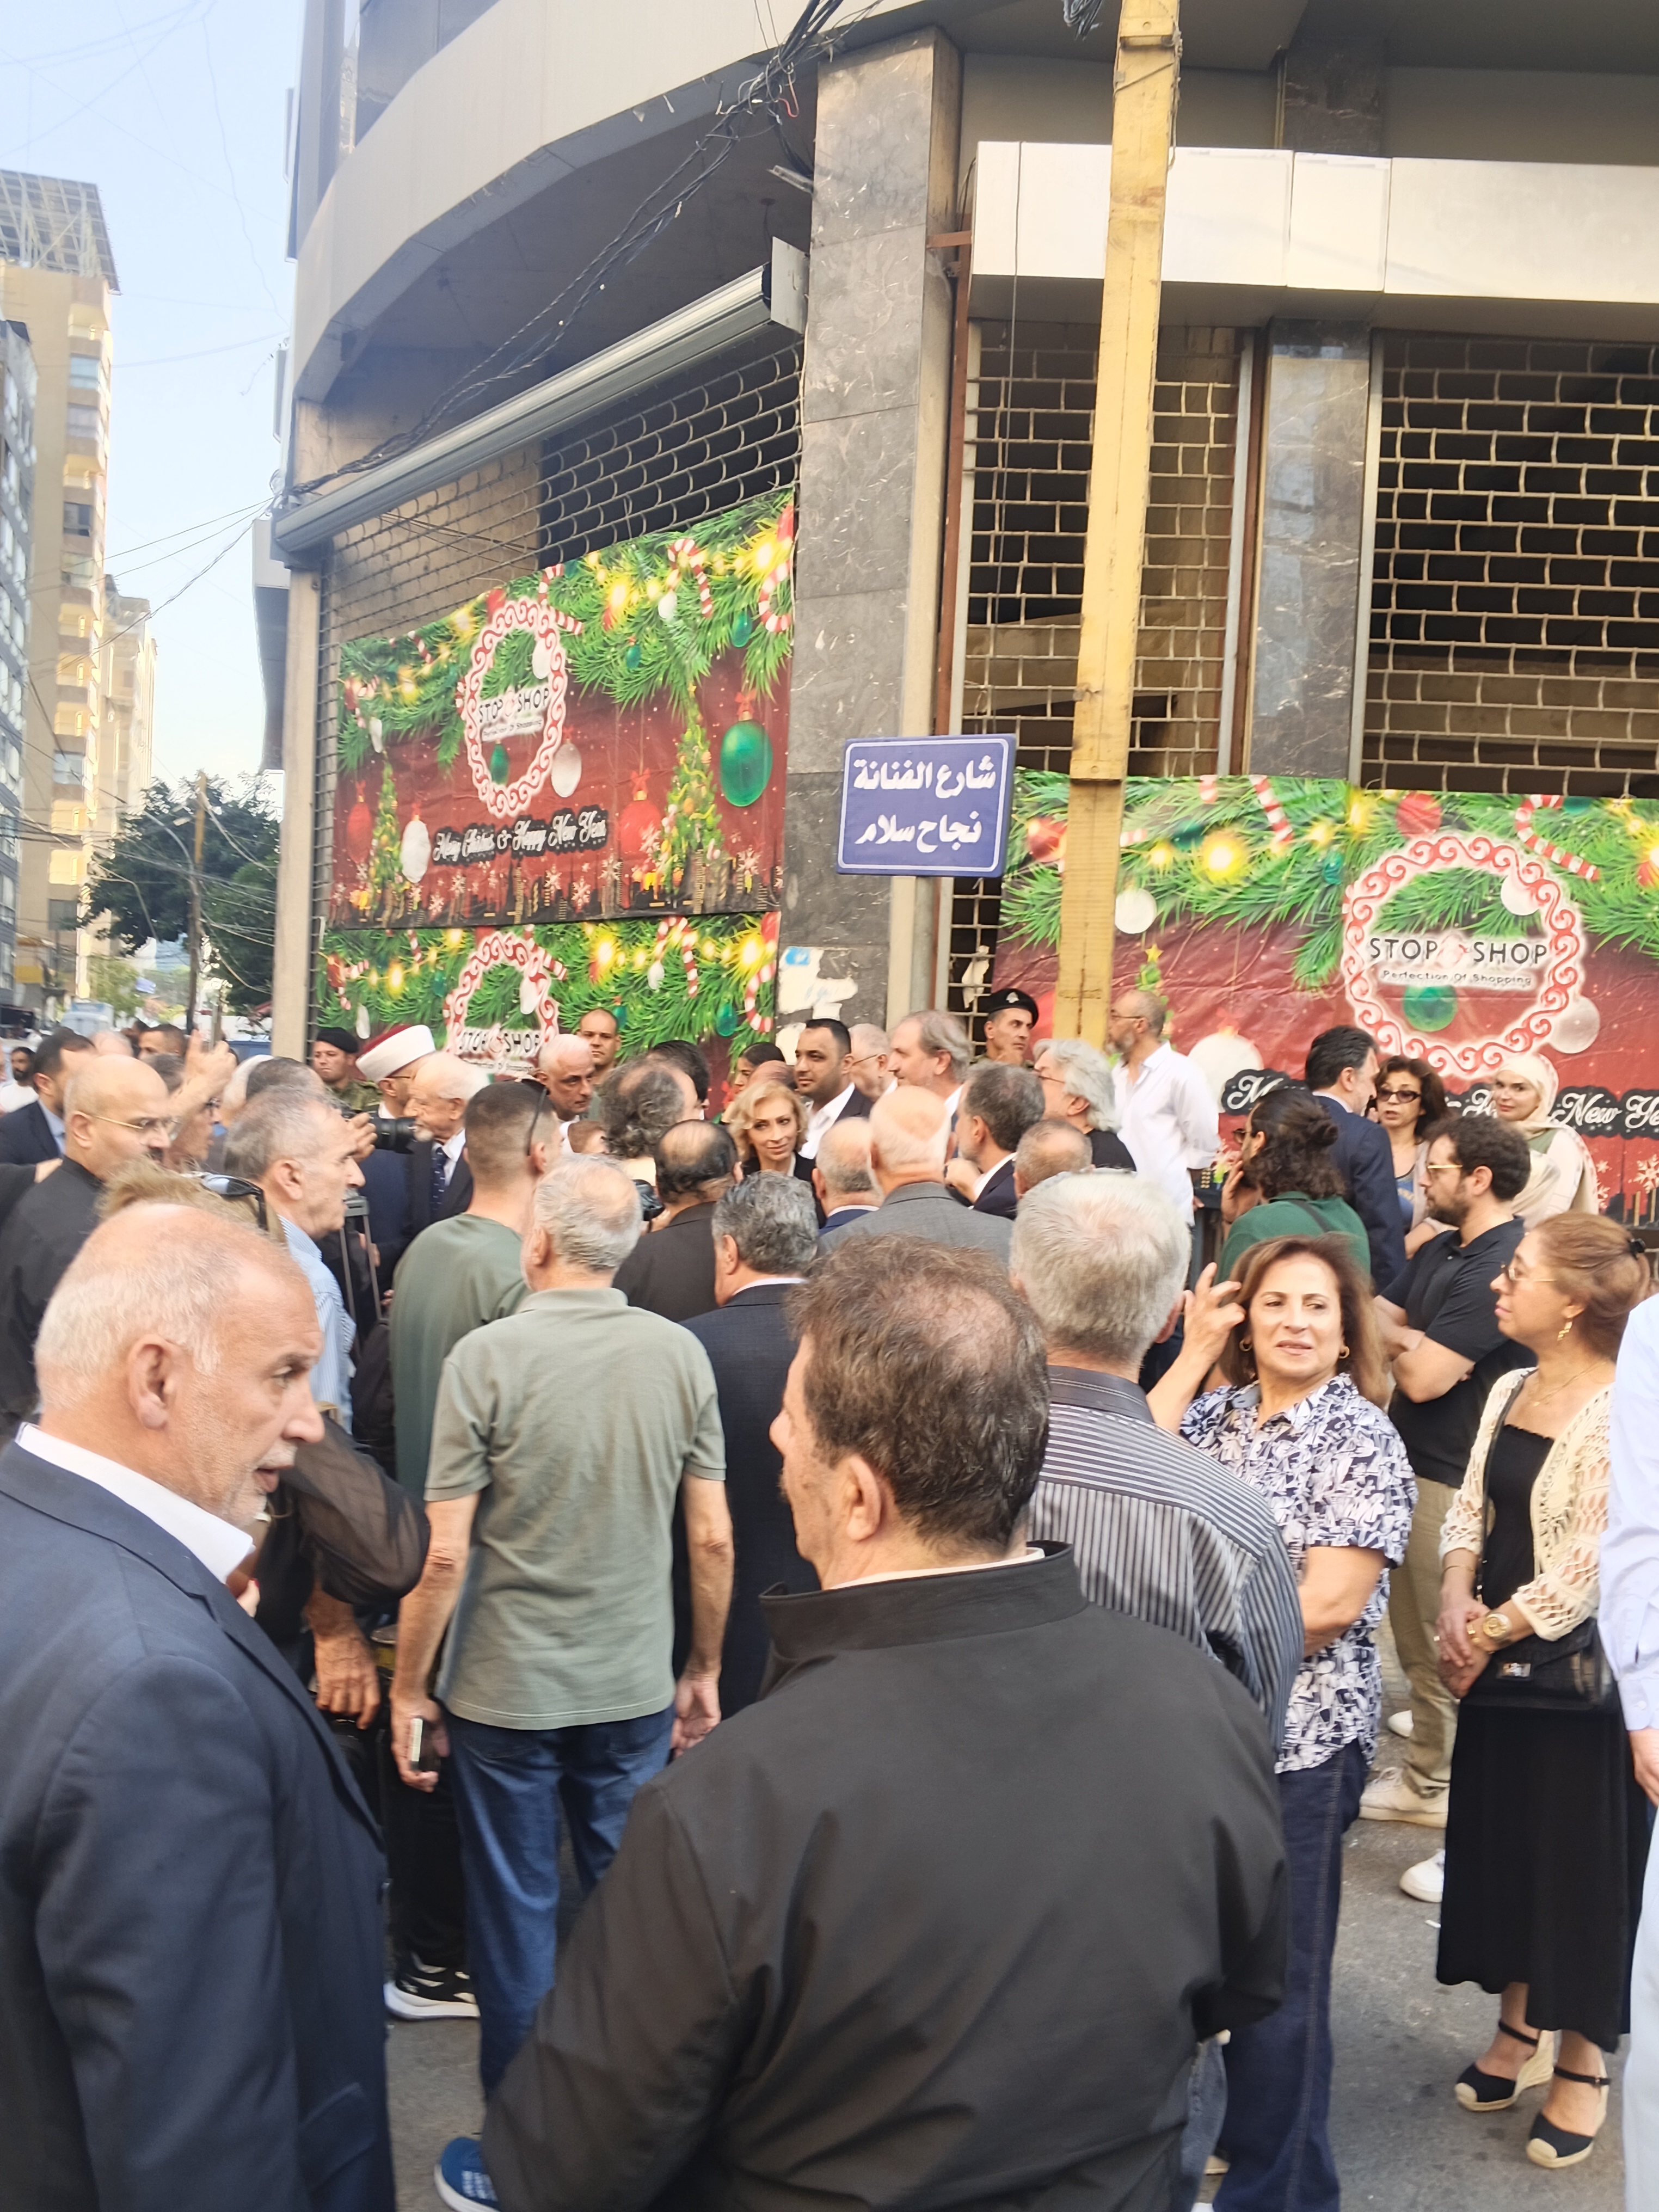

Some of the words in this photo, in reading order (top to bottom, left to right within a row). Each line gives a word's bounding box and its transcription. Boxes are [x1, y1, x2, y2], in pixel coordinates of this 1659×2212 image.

[517, 688, 550, 712] SHOP
[853, 758, 933, 790] الفنانة
[935, 754, 997, 798] شارع
[854, 814, 916, 845] سلام
[916, 810, 982, 853] نجاح
[1369, 937, 1438, 960] STOP
[1473, 941, 1547, 964] SHOP
[1382, 969, 1449, 981] Perfection
[1472, 973, 1532, 987] Shopping
[1547, 1092, 1623, 1126] New
[1624, 1095, 1659, 1129] Ye
